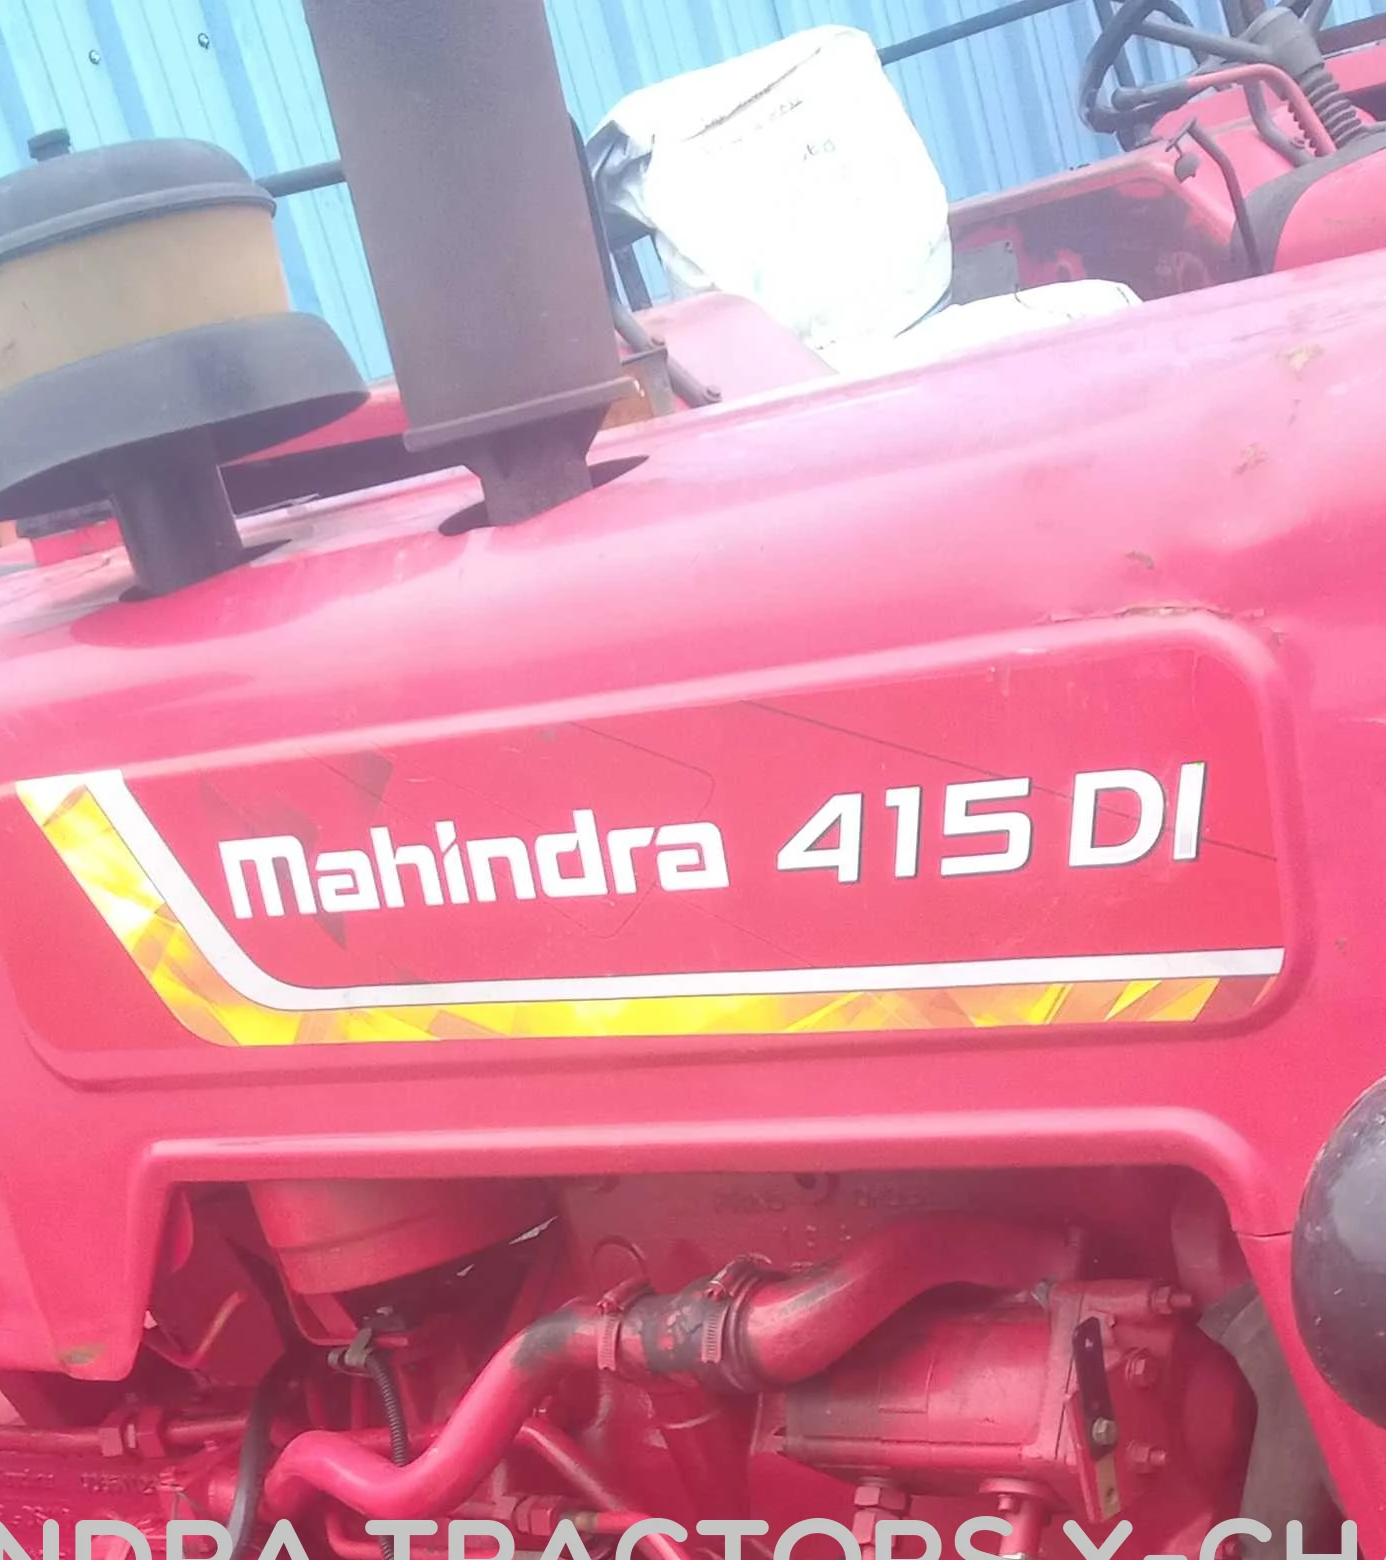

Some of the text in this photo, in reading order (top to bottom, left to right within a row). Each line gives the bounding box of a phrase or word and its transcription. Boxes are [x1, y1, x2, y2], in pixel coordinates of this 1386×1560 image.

[217, 761, 1207, 920] Mahindra 415 DI
